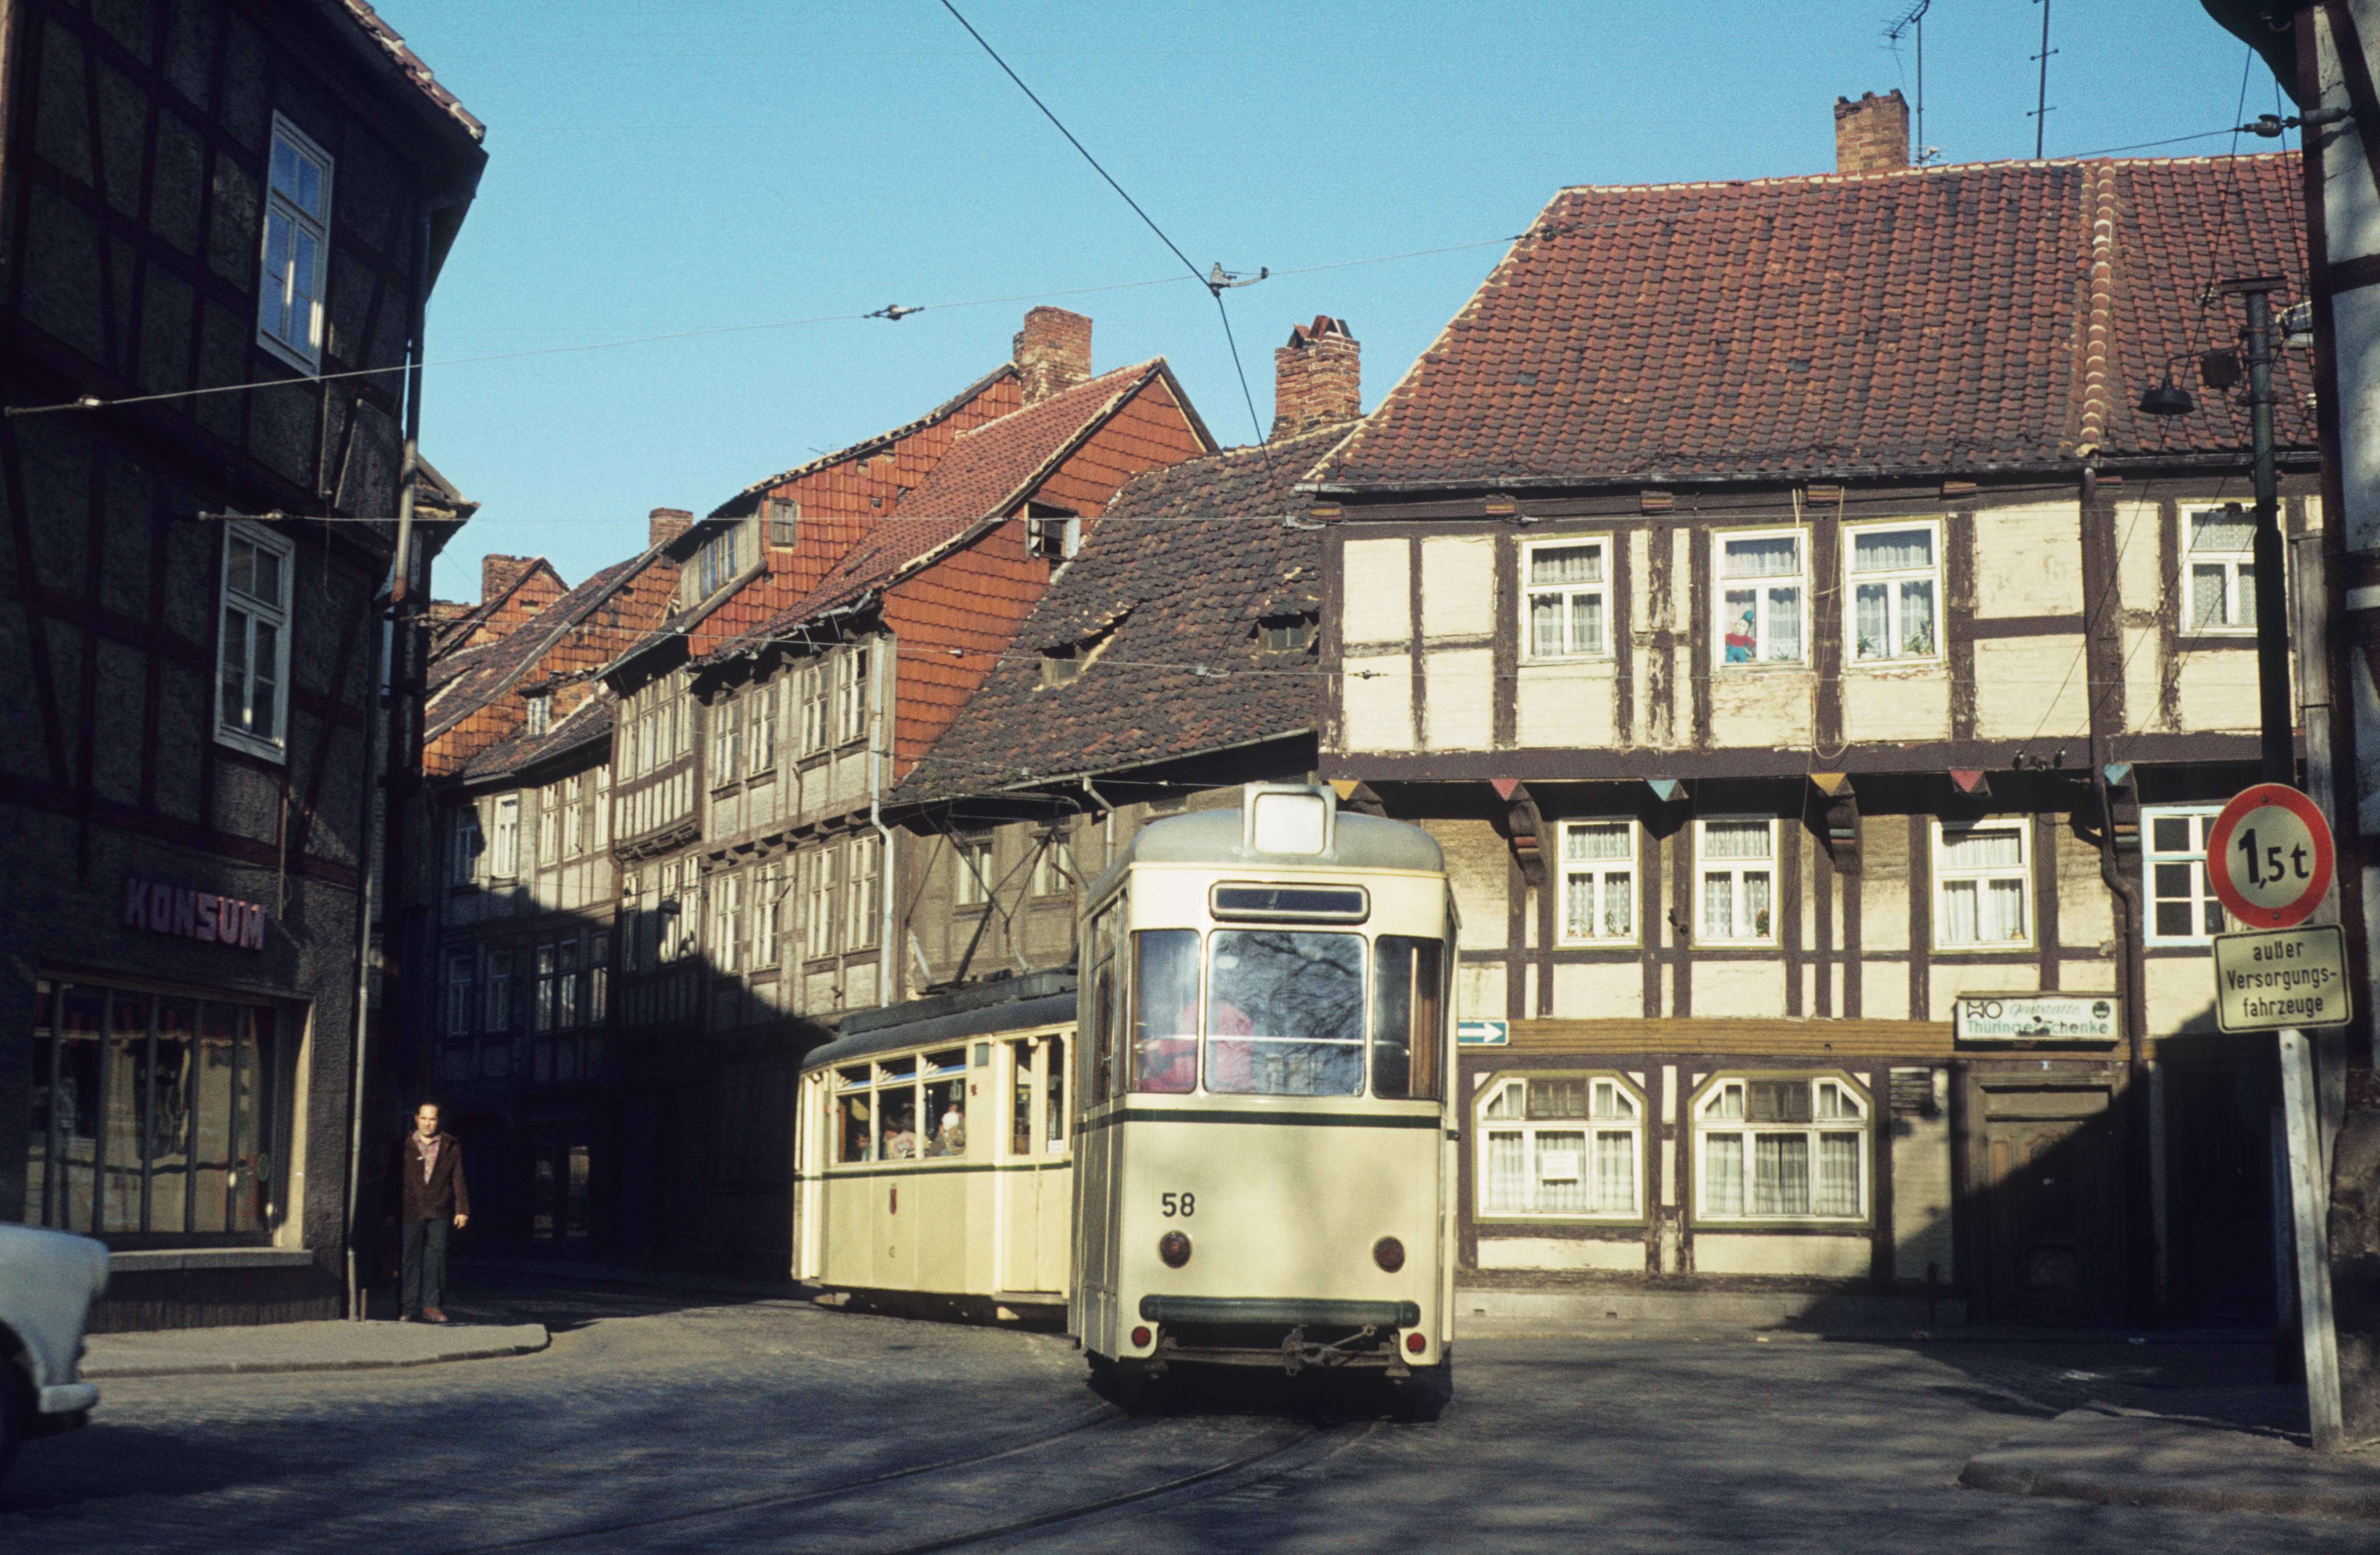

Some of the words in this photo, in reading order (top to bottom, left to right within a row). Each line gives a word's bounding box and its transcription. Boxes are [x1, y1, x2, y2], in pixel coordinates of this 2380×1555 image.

[2238, 828, 2285, 889] 1,5
[2290, 842, 2310, 879] t
[121, 877, 265, 950] KONSUM
[2253, 941, 2303, 961] außer
[2227, 968, 2338, 991] Versorgungs-
[2009, 1003, 2079, 1016] Gaststätte
[2243, 997, 2323, 1018] fahrzeuge
[1967, 1020, 2038, 1036] Thüringer
[1162, 1192, 1195, 1218] 58
